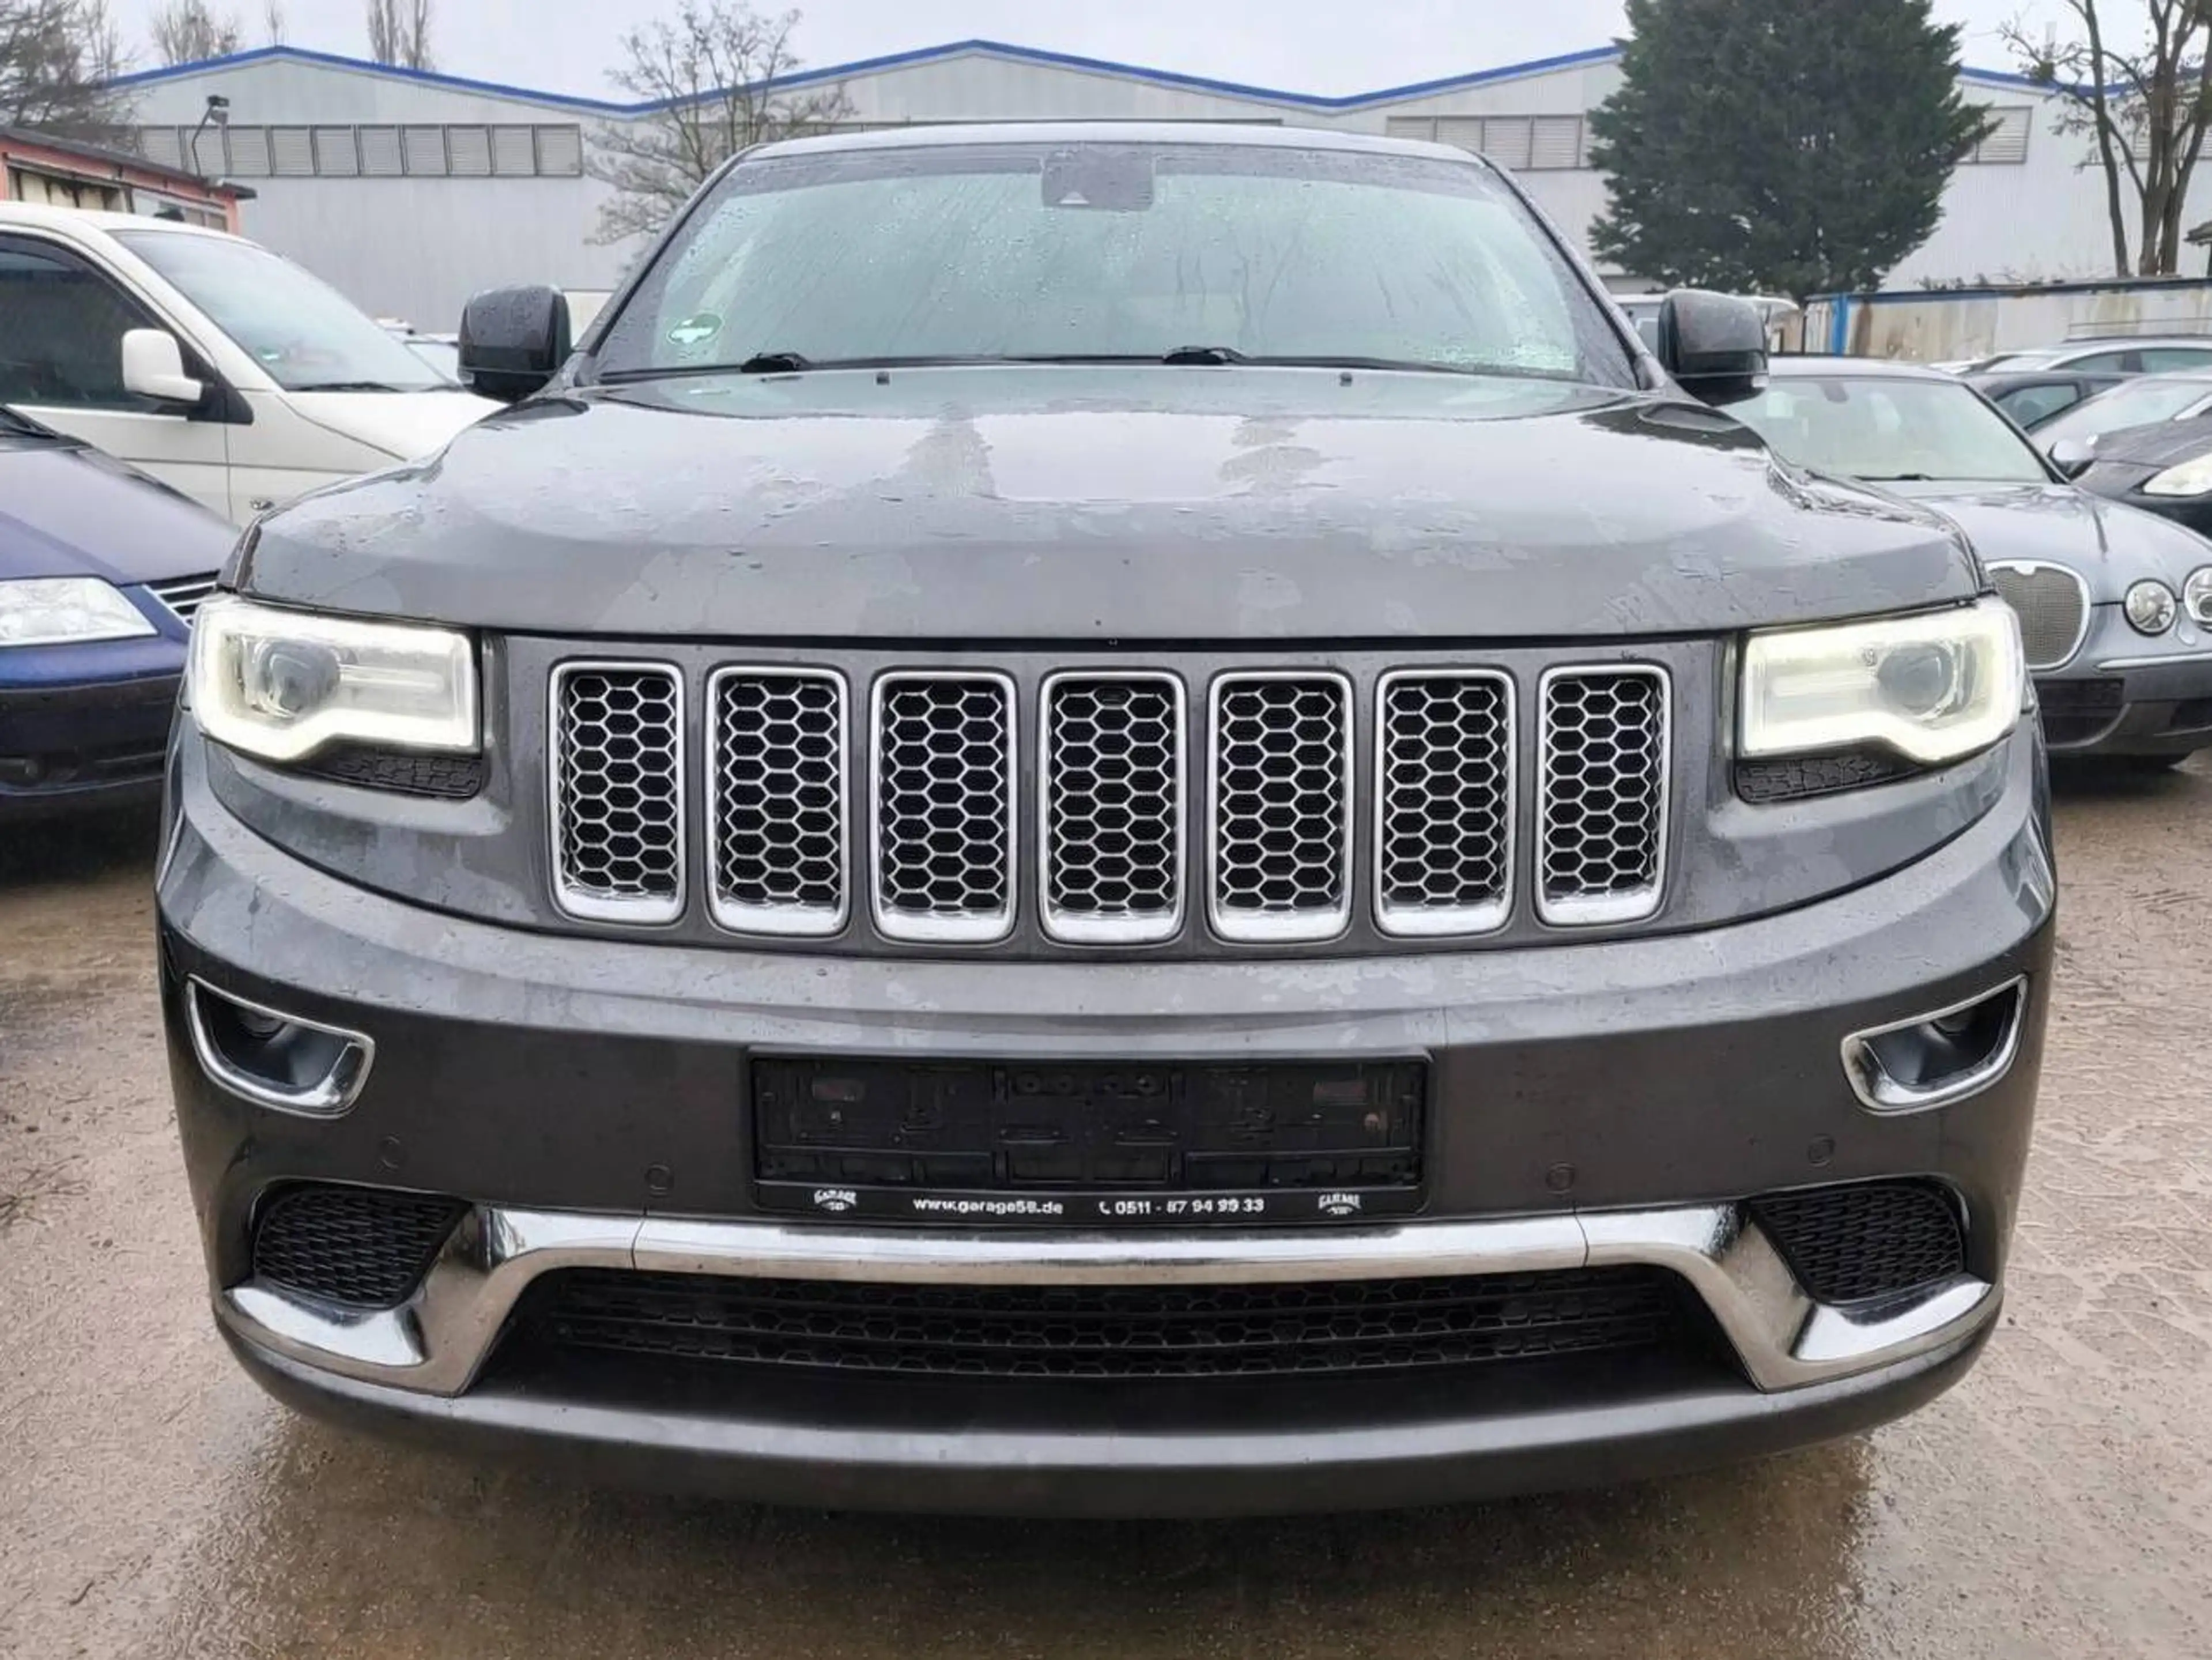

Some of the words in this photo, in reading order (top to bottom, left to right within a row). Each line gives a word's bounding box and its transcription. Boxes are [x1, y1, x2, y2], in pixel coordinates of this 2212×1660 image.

[1115, 1200, 1151, 1214] 0511
[1167, 1200, 1188, 1213] 87
[1192, 1199, 1213, 1212] 94
[1218, 1198, 1239, 1213] 99
[1243, 1198, 1264, 1212] 33
